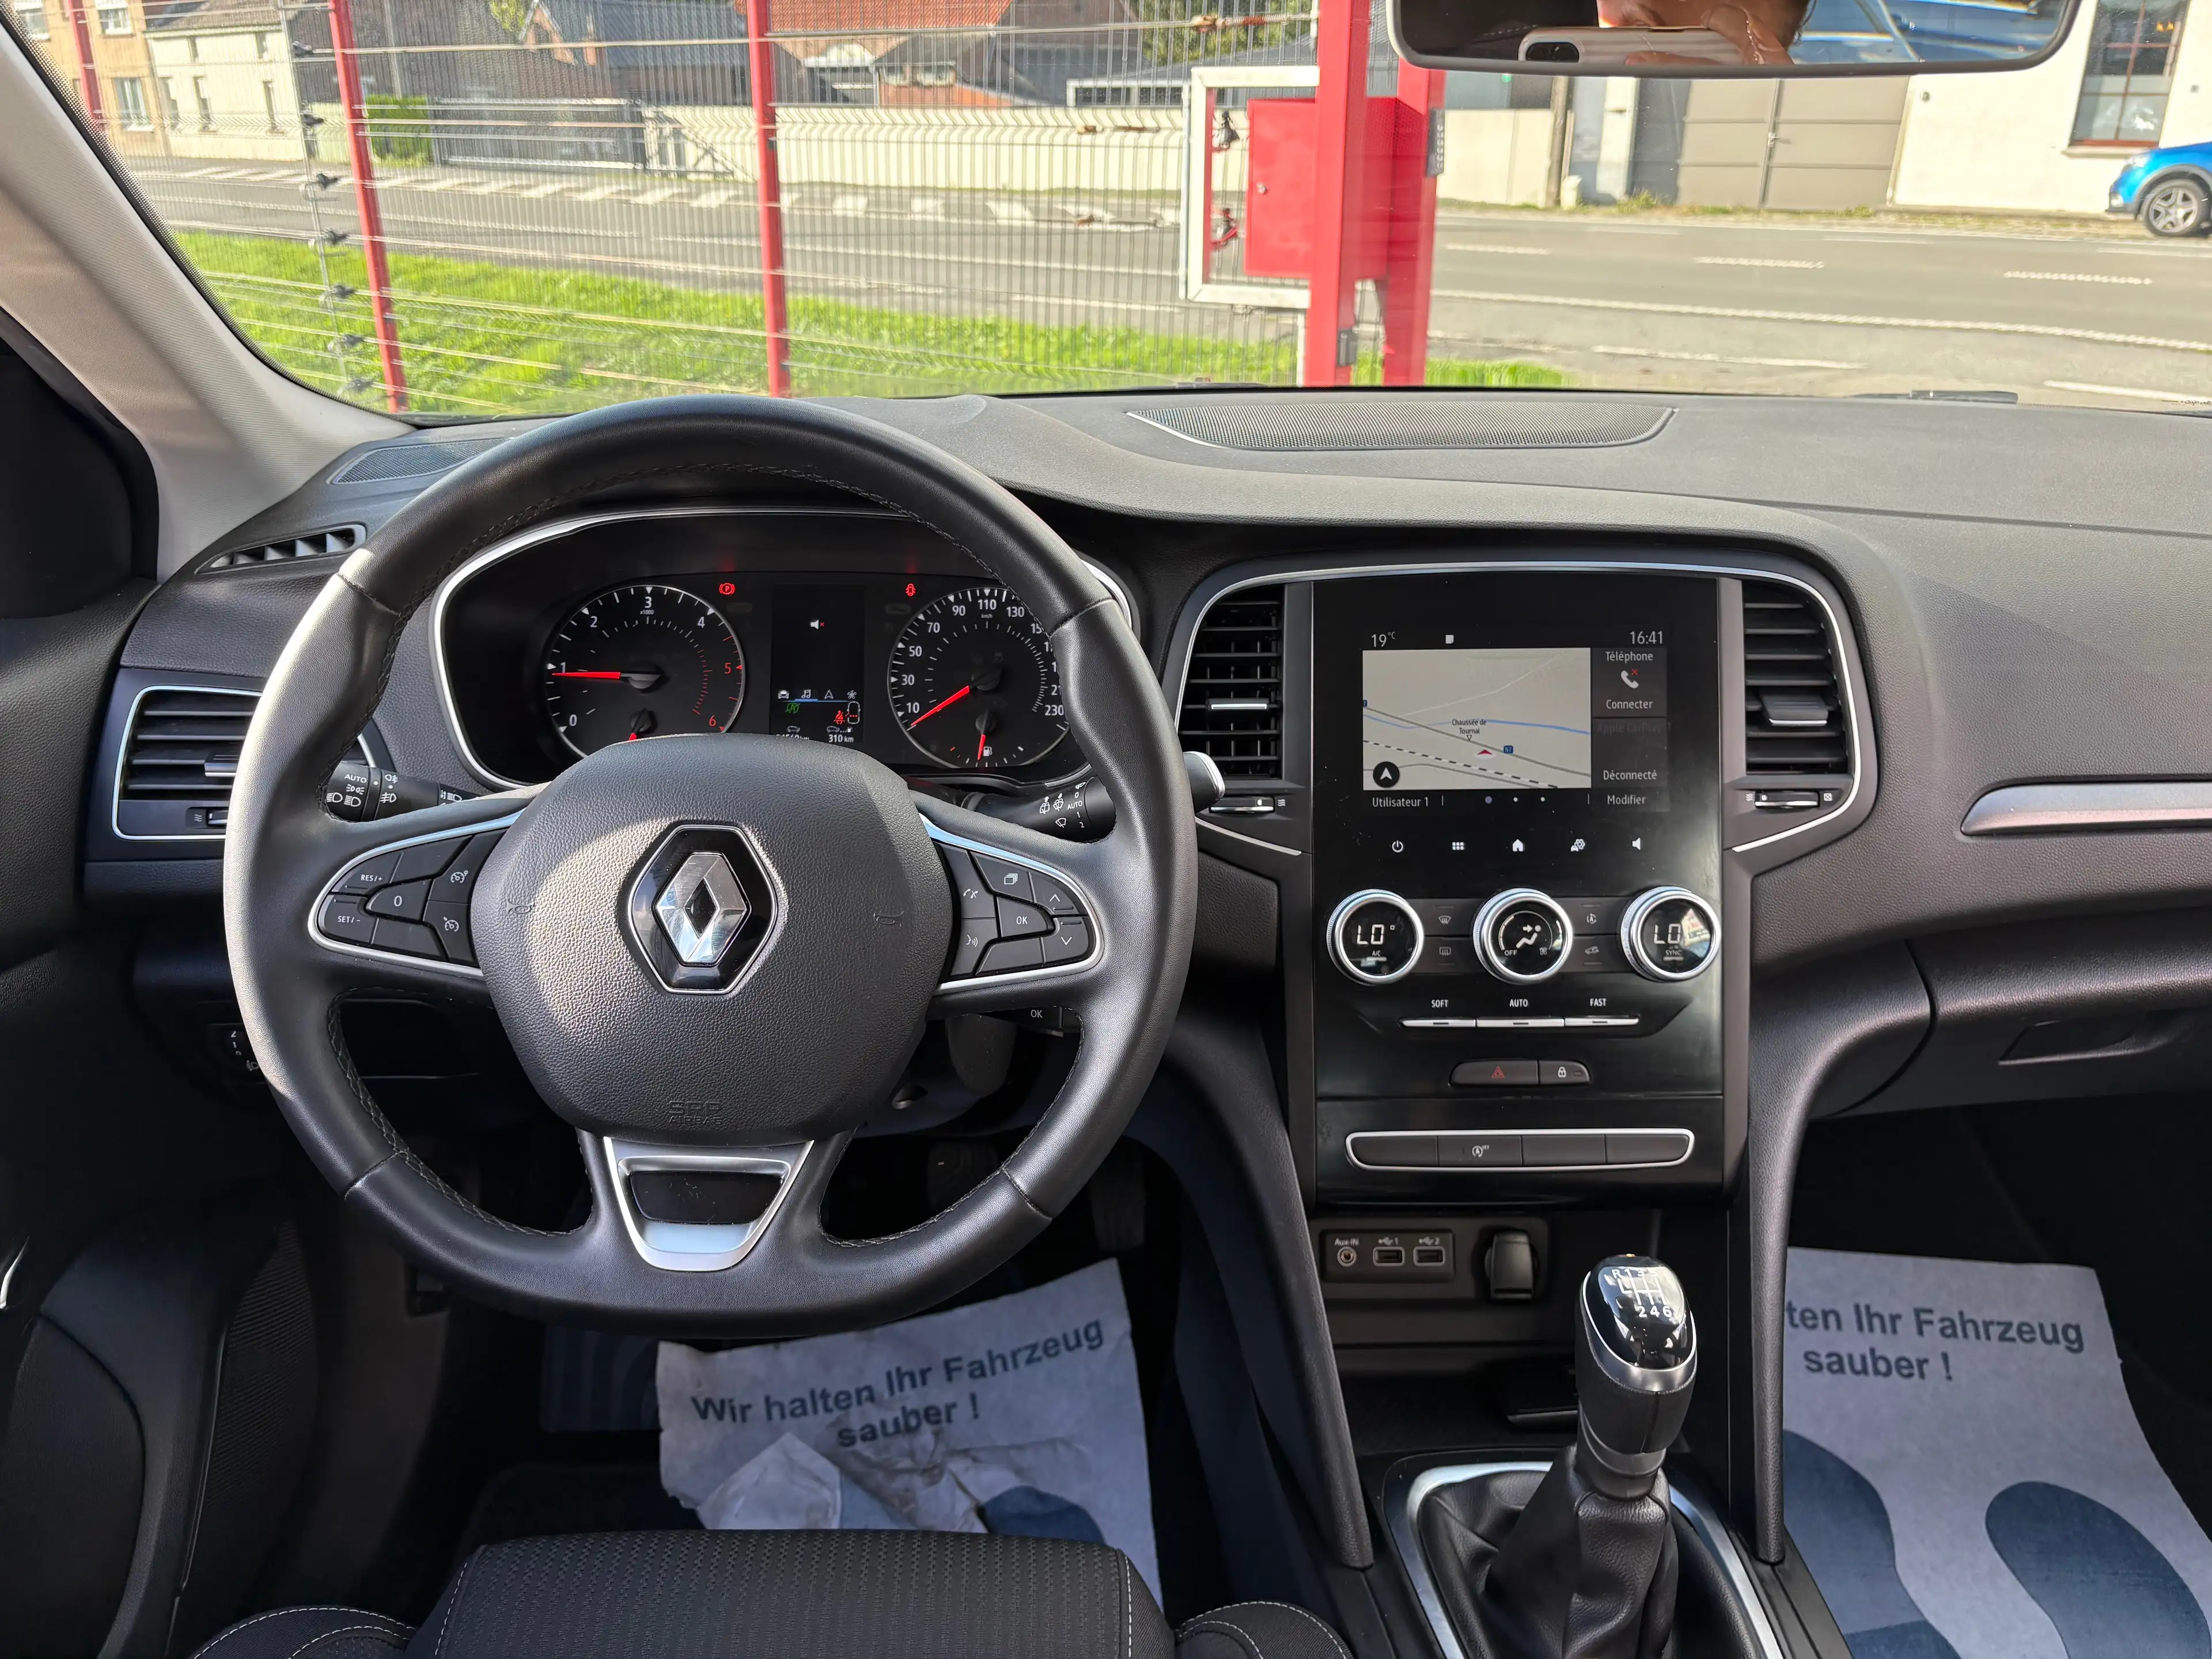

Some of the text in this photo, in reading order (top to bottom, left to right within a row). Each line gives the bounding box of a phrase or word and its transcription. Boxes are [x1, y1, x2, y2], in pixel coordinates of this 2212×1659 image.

[645, 596, 652, 608] 3
[978, 599, 997, 610] 110
[952, 605, 966, 616] 90
[1006, 607, 1025, 618] 130
[590, 616, 598, 628] 2
[698, 616, 705, 628] 4
[927, 622, 940, 633] 70
[1031, 623, 1042, 634] 15
[1630, 631, 1663, 645] 16:41
[909, 646, 922, 657] 50
[1605, 651, 1654, 664] Téléphone
[560, 662, 566, 673] 1
[725, 662, 731, 674] 5
[901, 674, 915, 685] 30
[906, 702, 920, 714] 10
[1606, 699, 1653, 709] Connecter
[1045, 704, 1064, 716] 230
[569, 714, 577, 726] 0
[709, 715, 716, 726] 6
[828, 734, 843, 743] 310
[344, 774, 367, 783] AUTO
[1603, 770, 1657, 781] Déconnecté
[1067, 800, 1083, 810] AUTO
[1372, 796, 1428, 807] Utilisateur 1
[1607, 794, 1647, 805] Modifier
[393, 895, 403, 907] 0
[1016, 916, 1028, 925] OK
[1431, 999, 1449, 1008] SOFT
[1509, 999, 1528, 1007] AUTO
[1590, 998, 1607, 1006] FAST
[1031, 1009, 1043, 1018] OK
[1611, 1269, 1623, 1279] R
[1624, 1268, 1631, 1277] 1
[1638, 1268, 1646, 1277] 3
[1639, 1305, 1672, 1317] 2 4 6
[1854, 1304, 1902, 1335] Ihr
[1913, 1308, 2084, 1353] Fahrzeug
[1804, 1348, 1953, 1381] sauber !
[693, 1319, 1104, 1423] Wir halten Ihr Fahrzeug
[837, 1393, 980, 1448] sauber !
